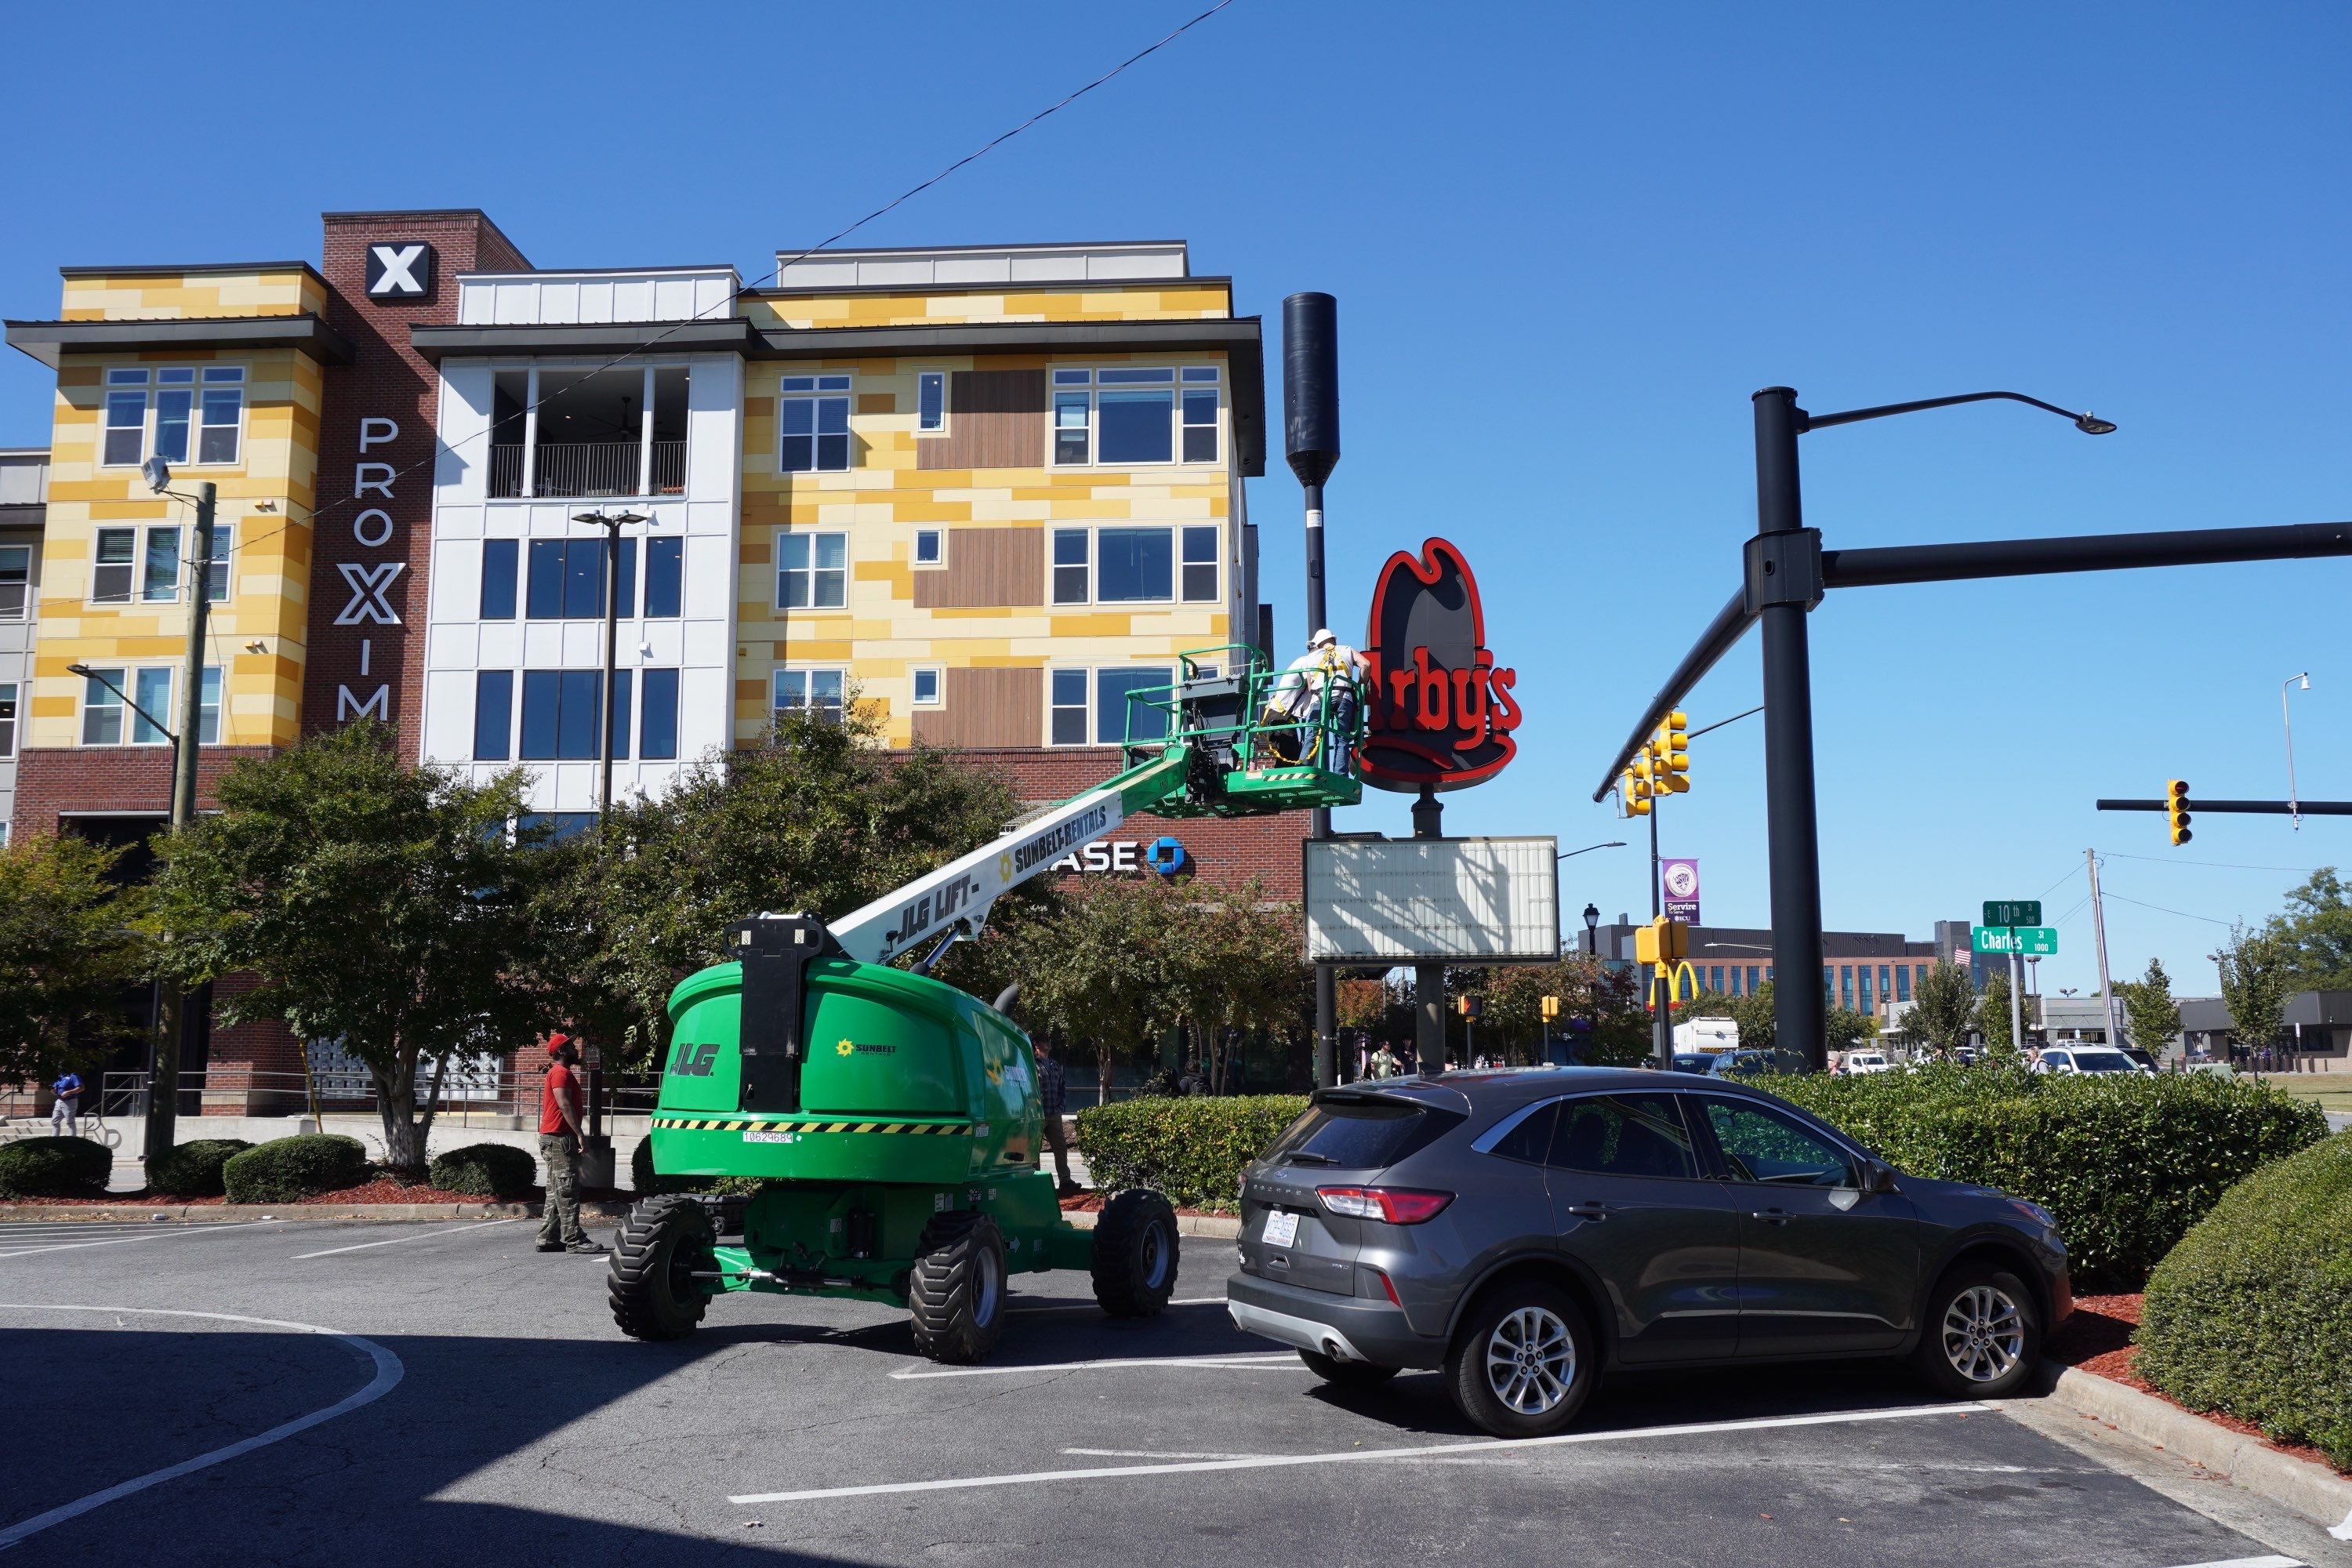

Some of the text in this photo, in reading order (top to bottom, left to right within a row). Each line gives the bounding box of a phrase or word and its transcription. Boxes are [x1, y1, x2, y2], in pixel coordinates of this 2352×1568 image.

[370, 245, 424, 293] X
[1043, 841, 1138, 871] ASE
[2027, 903, 2033, 912] St
[898, 896, 931, 945] JLG
[2038, 930, 2045, 939] St
[2034, 943, 2049, 952] 1000
[855, 1044, 897, 1053] SUNBELT
[670, 1044, 720, 1076] JLG
[745, 1132, 793, 1142] 10629689
